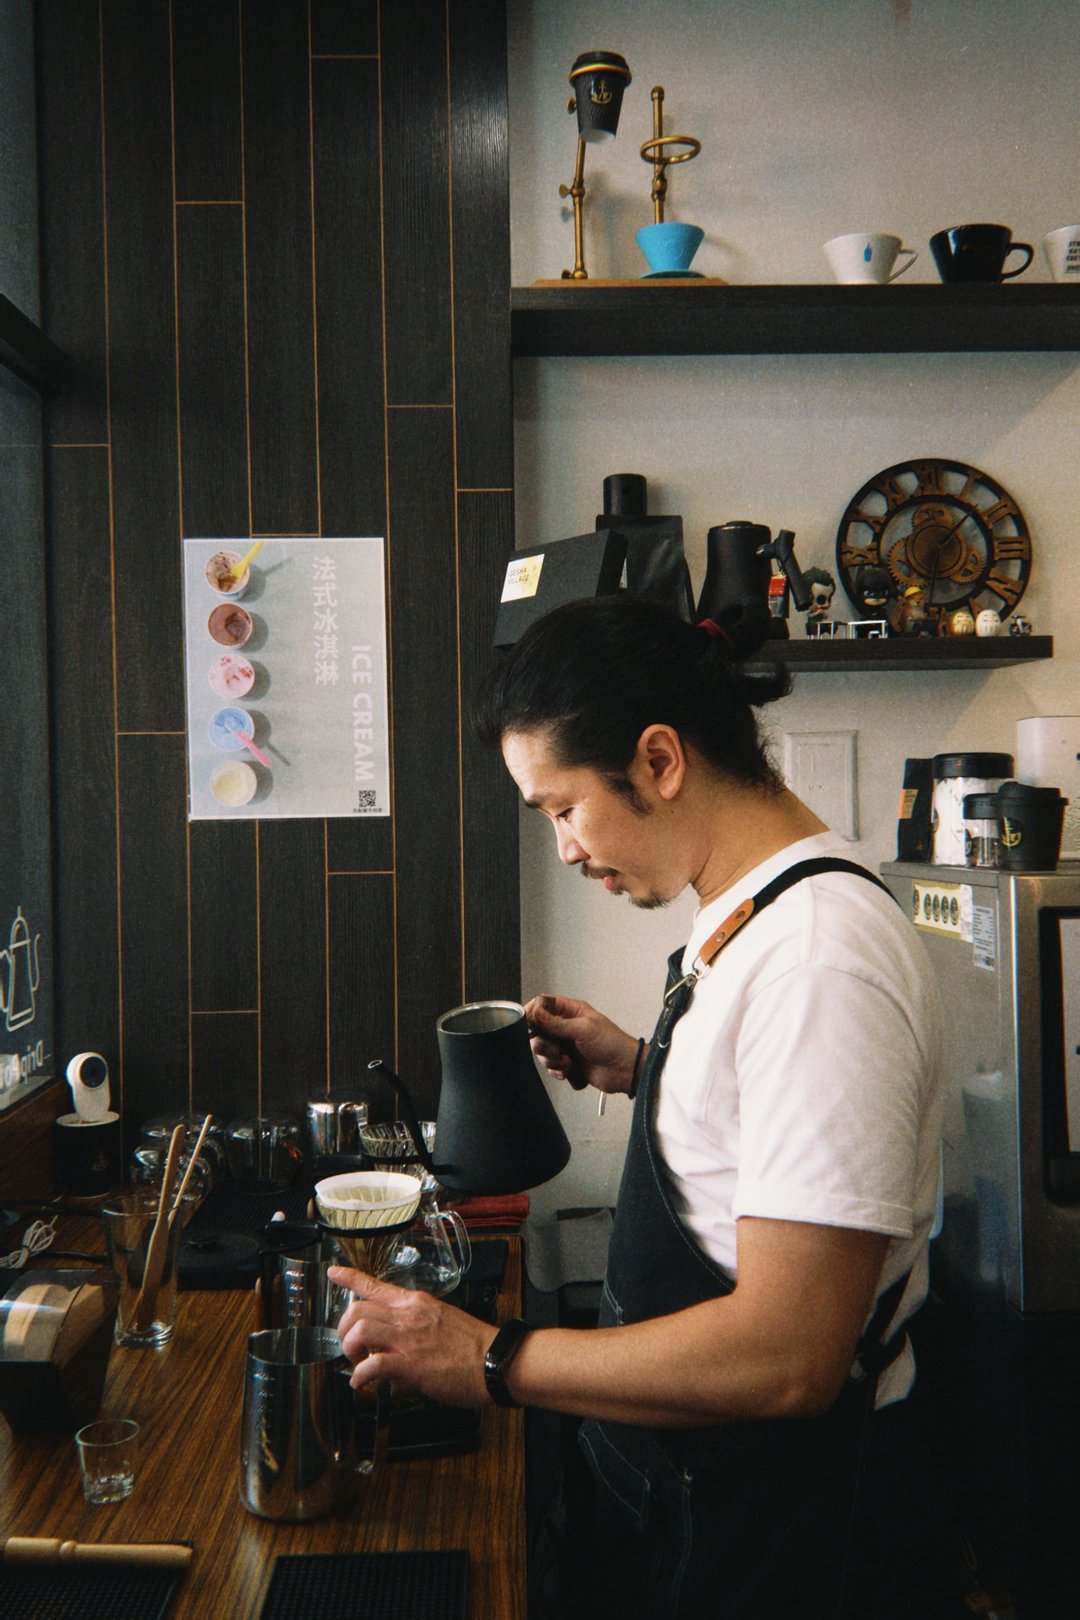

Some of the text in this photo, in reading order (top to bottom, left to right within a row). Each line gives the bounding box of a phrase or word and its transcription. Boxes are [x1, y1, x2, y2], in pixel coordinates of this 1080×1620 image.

[311, 556, 339, 686] 法式冰淇淋
[351, 645, 372, 684] ICE
[351, 693, 375, 782] CREAM
